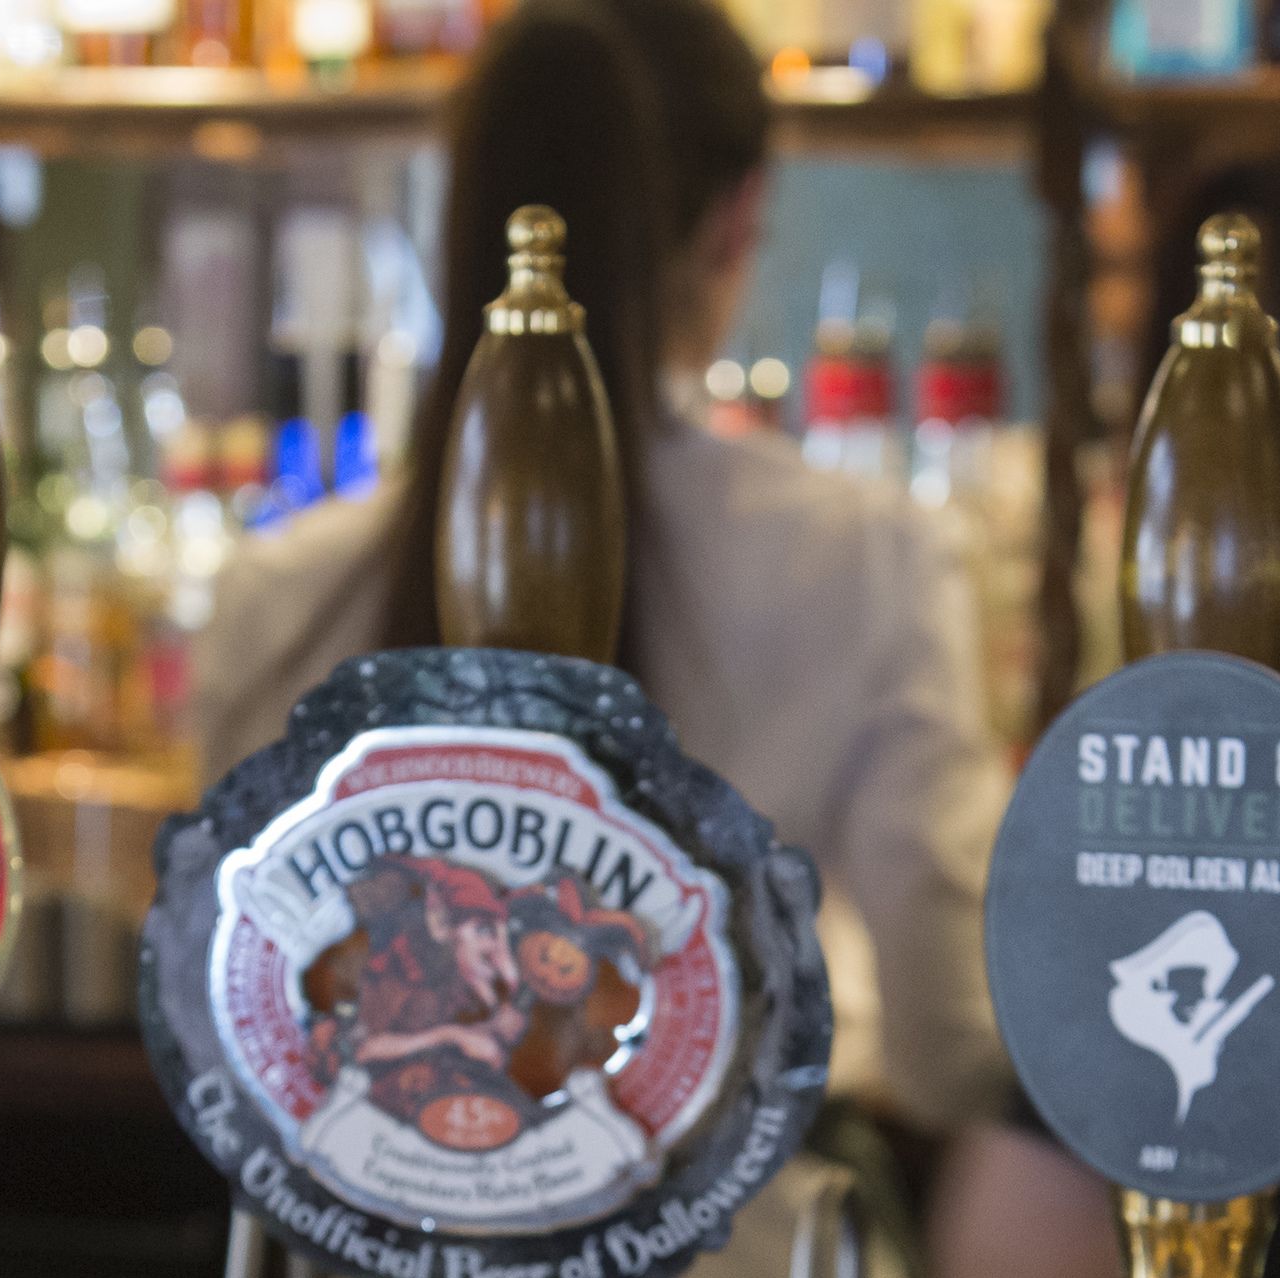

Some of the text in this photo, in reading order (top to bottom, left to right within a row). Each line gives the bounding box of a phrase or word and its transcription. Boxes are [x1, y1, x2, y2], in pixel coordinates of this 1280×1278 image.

[1078, 733, 1246, 788] STAND
[288, 798, 655, 911] HOBGOBLIN
[1076, 851, 1143, 887] DEEP
[1145, 855, 1247, 891] GOLDEN
[604, 1106, 788, 1277] Halloween
